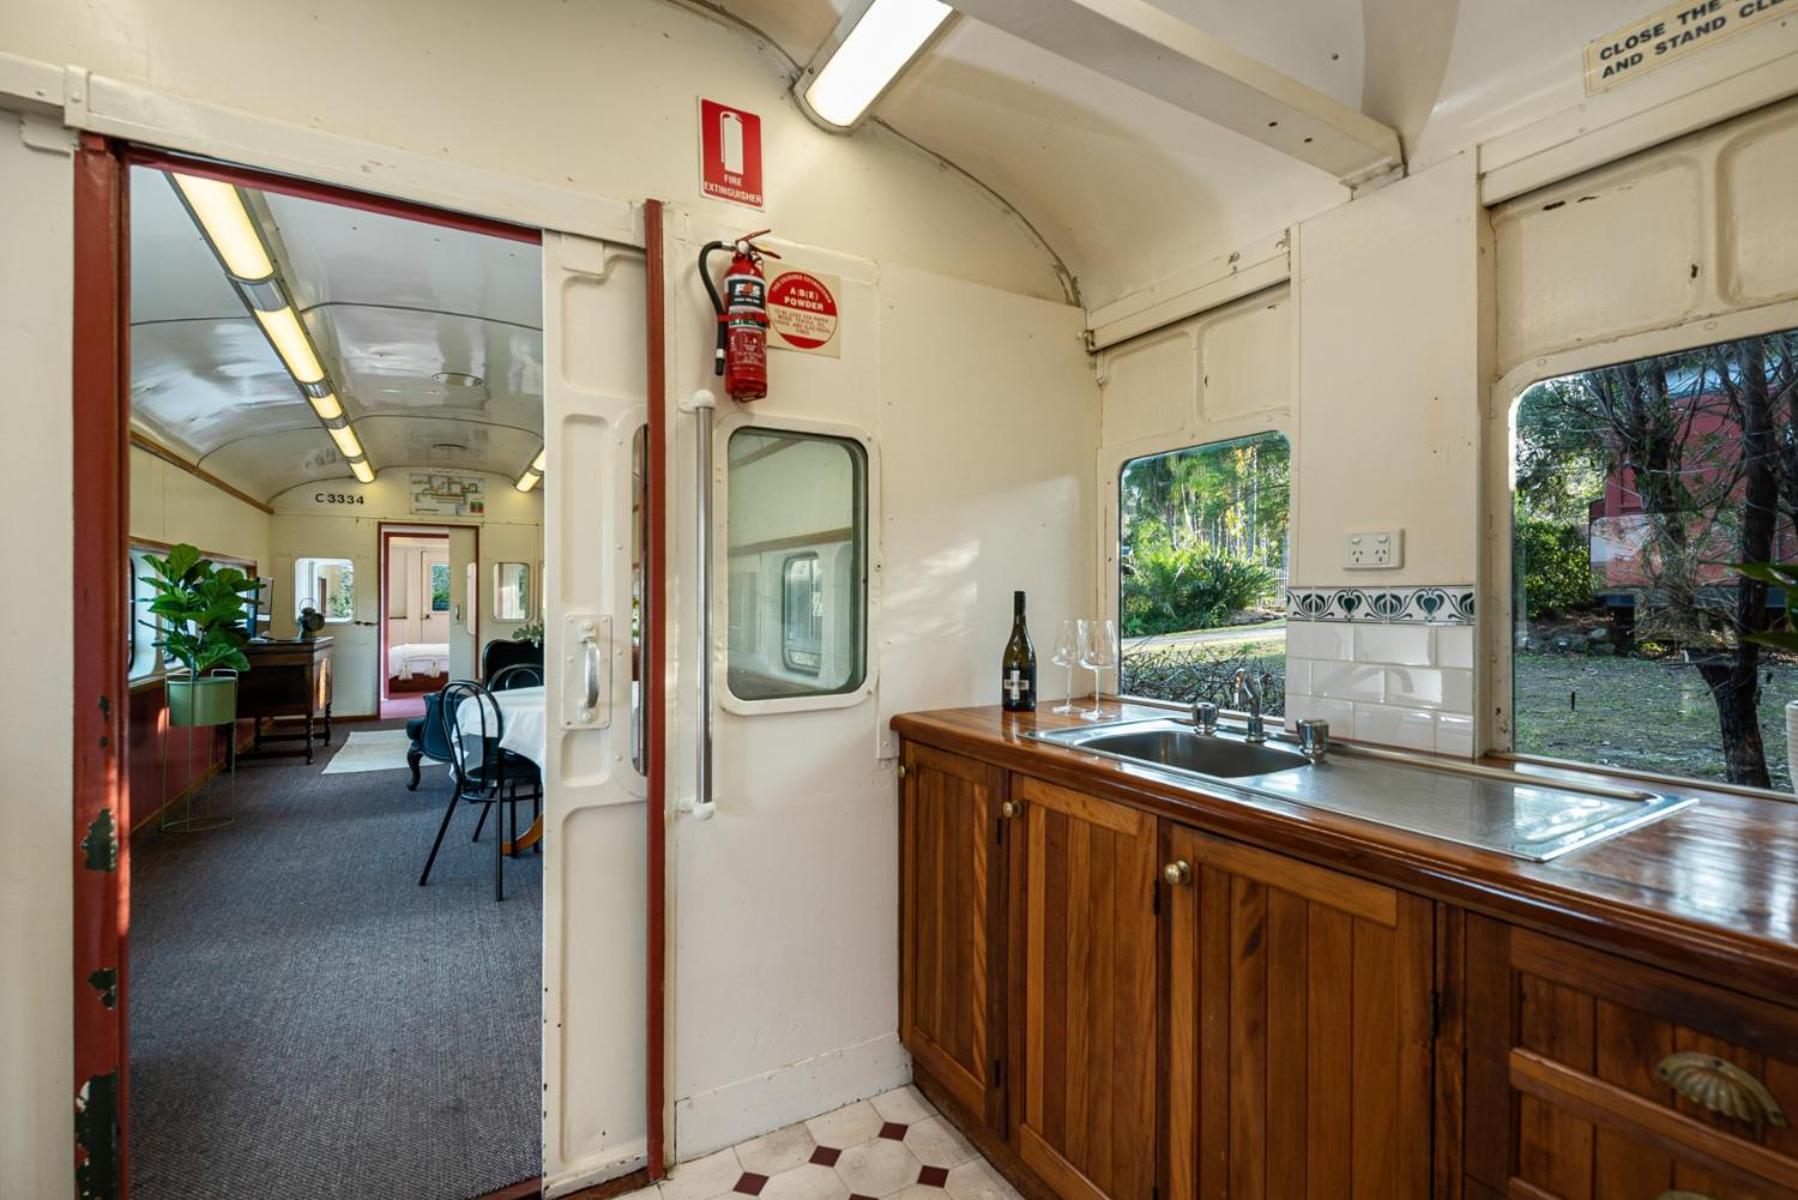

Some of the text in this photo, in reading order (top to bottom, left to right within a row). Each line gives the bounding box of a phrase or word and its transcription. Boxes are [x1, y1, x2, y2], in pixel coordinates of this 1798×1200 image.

[1600, 0, 1722, 60] CLOSE THE
[1602, 53, 1644, 79] AND
[1655, 16, 1727, 55] STAND
[723, 174, 743, 187] FIRE
[704, 181, 763, 205] EXTINGUISHER
[783, 295, 825, 312] POWDER
